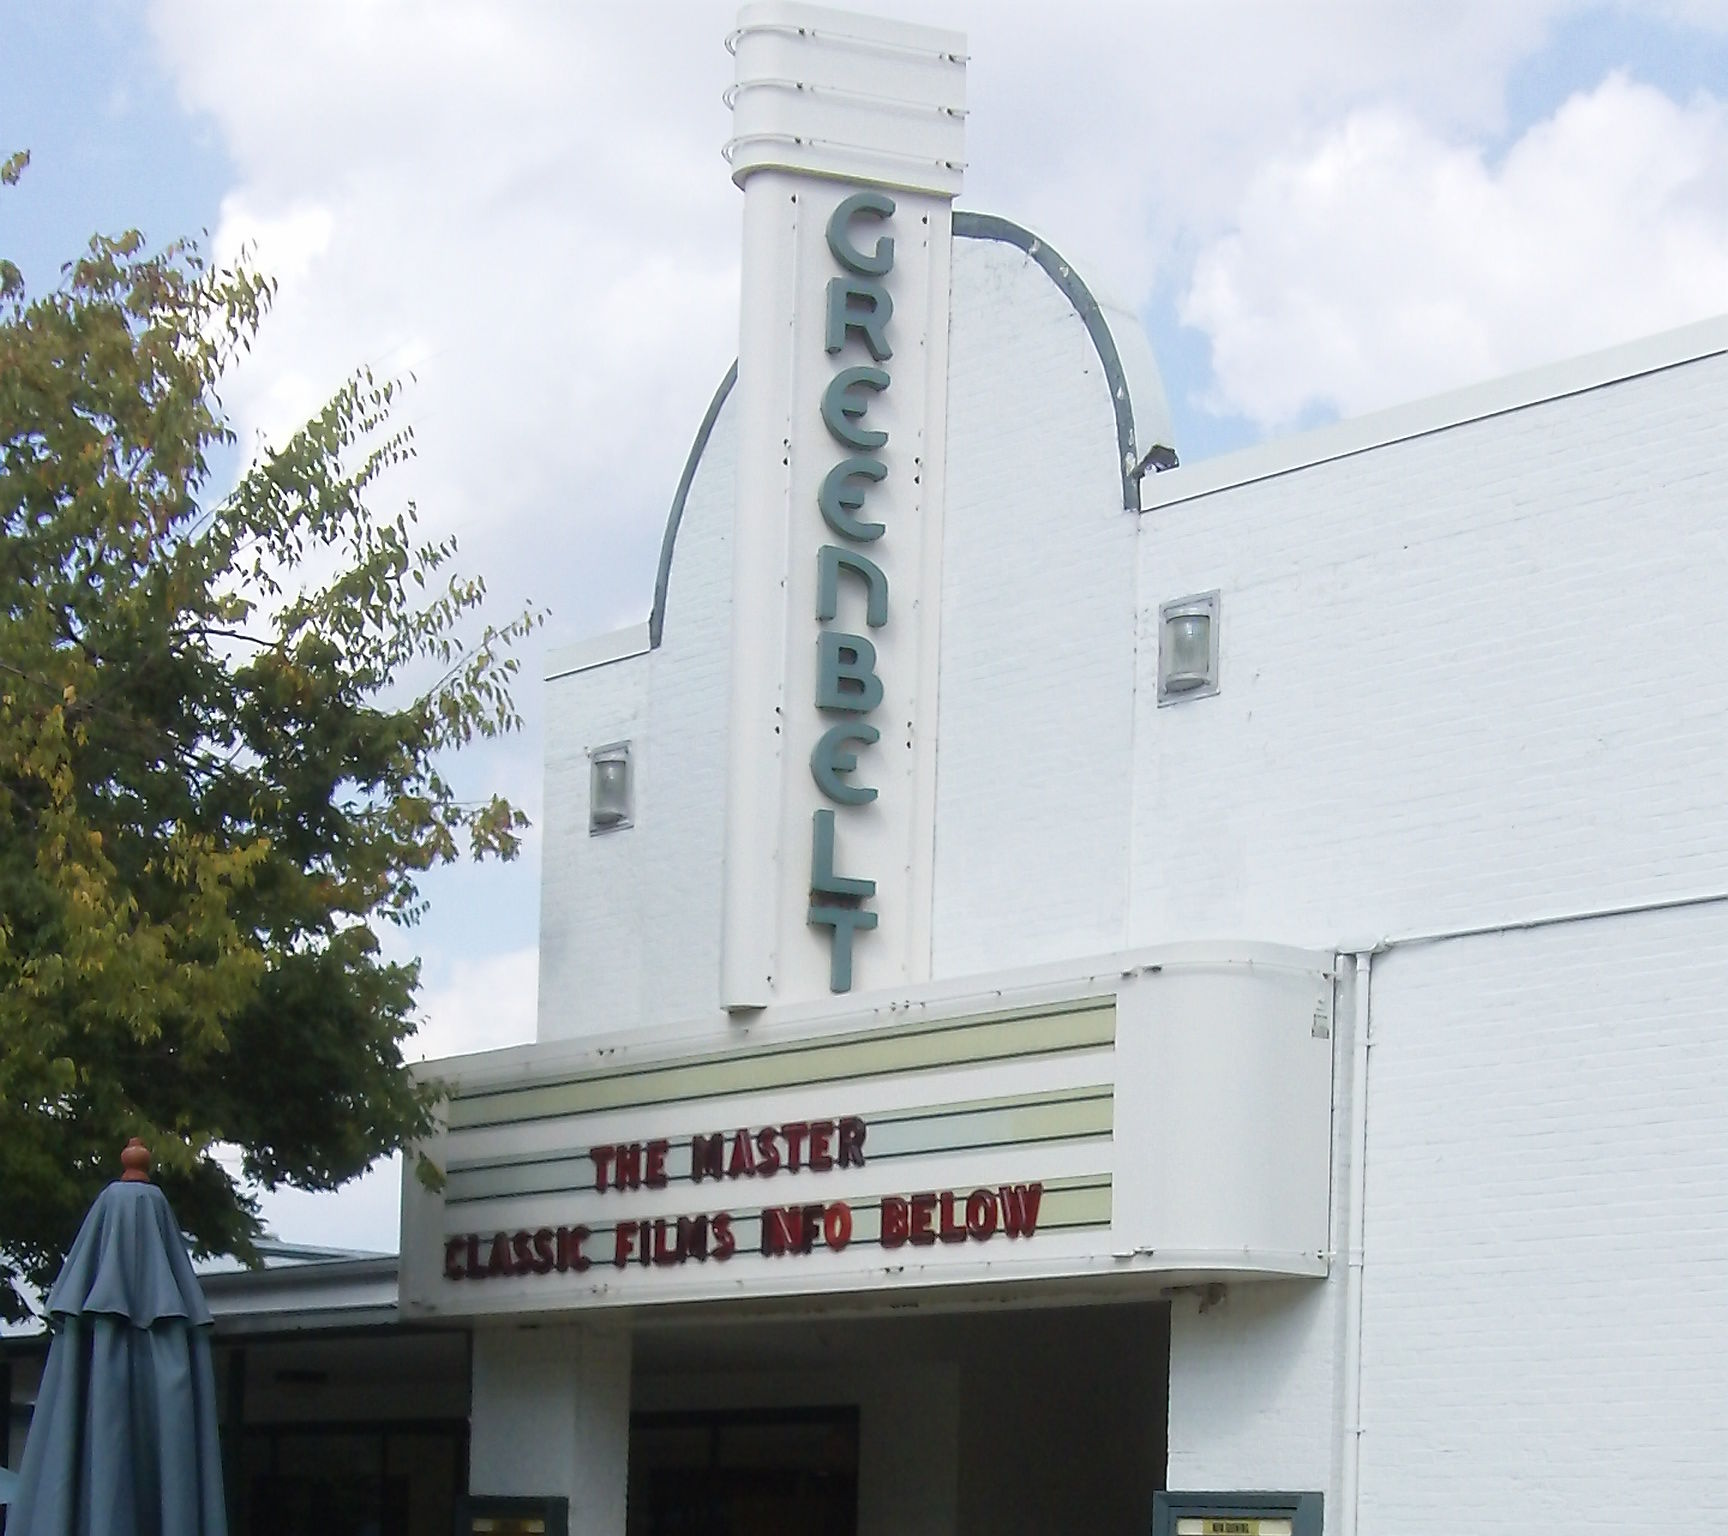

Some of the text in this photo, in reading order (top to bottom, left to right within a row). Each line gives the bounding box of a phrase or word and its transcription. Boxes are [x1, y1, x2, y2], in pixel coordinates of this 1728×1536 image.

[589, 1115, 867, 1194] THE MASTER
[444, 1181, 1045, 1280] CLASSIC FILMS INFO BELOW
